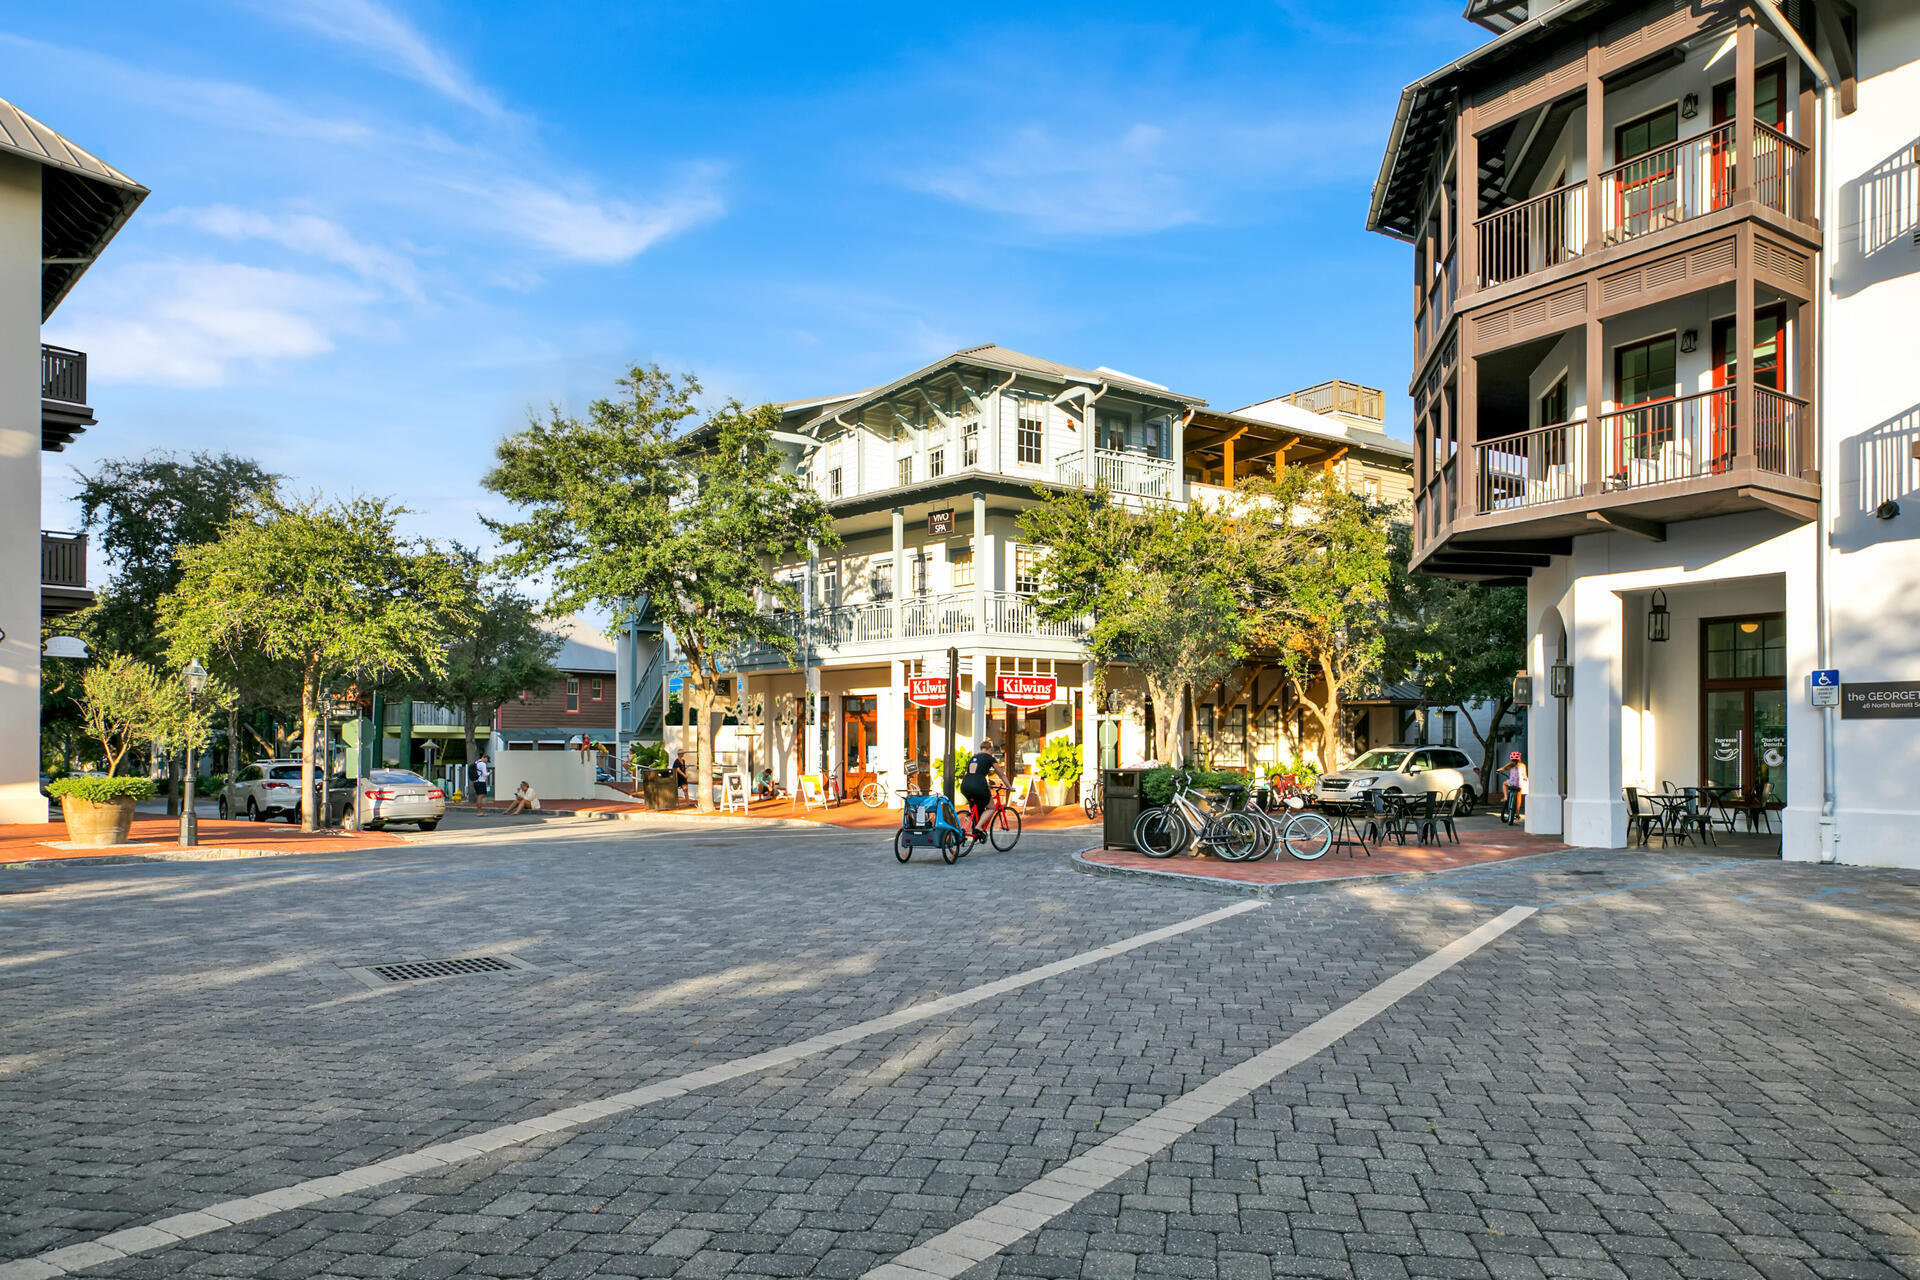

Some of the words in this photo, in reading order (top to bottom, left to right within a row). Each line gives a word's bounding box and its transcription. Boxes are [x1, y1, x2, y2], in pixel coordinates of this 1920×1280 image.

[933, 512, 949, 522] VIVO
[935, 524, 946, 533] SPA
[1003, 679, 1051, 694] Kilwins
[1848, 692, 1866, 701] the
